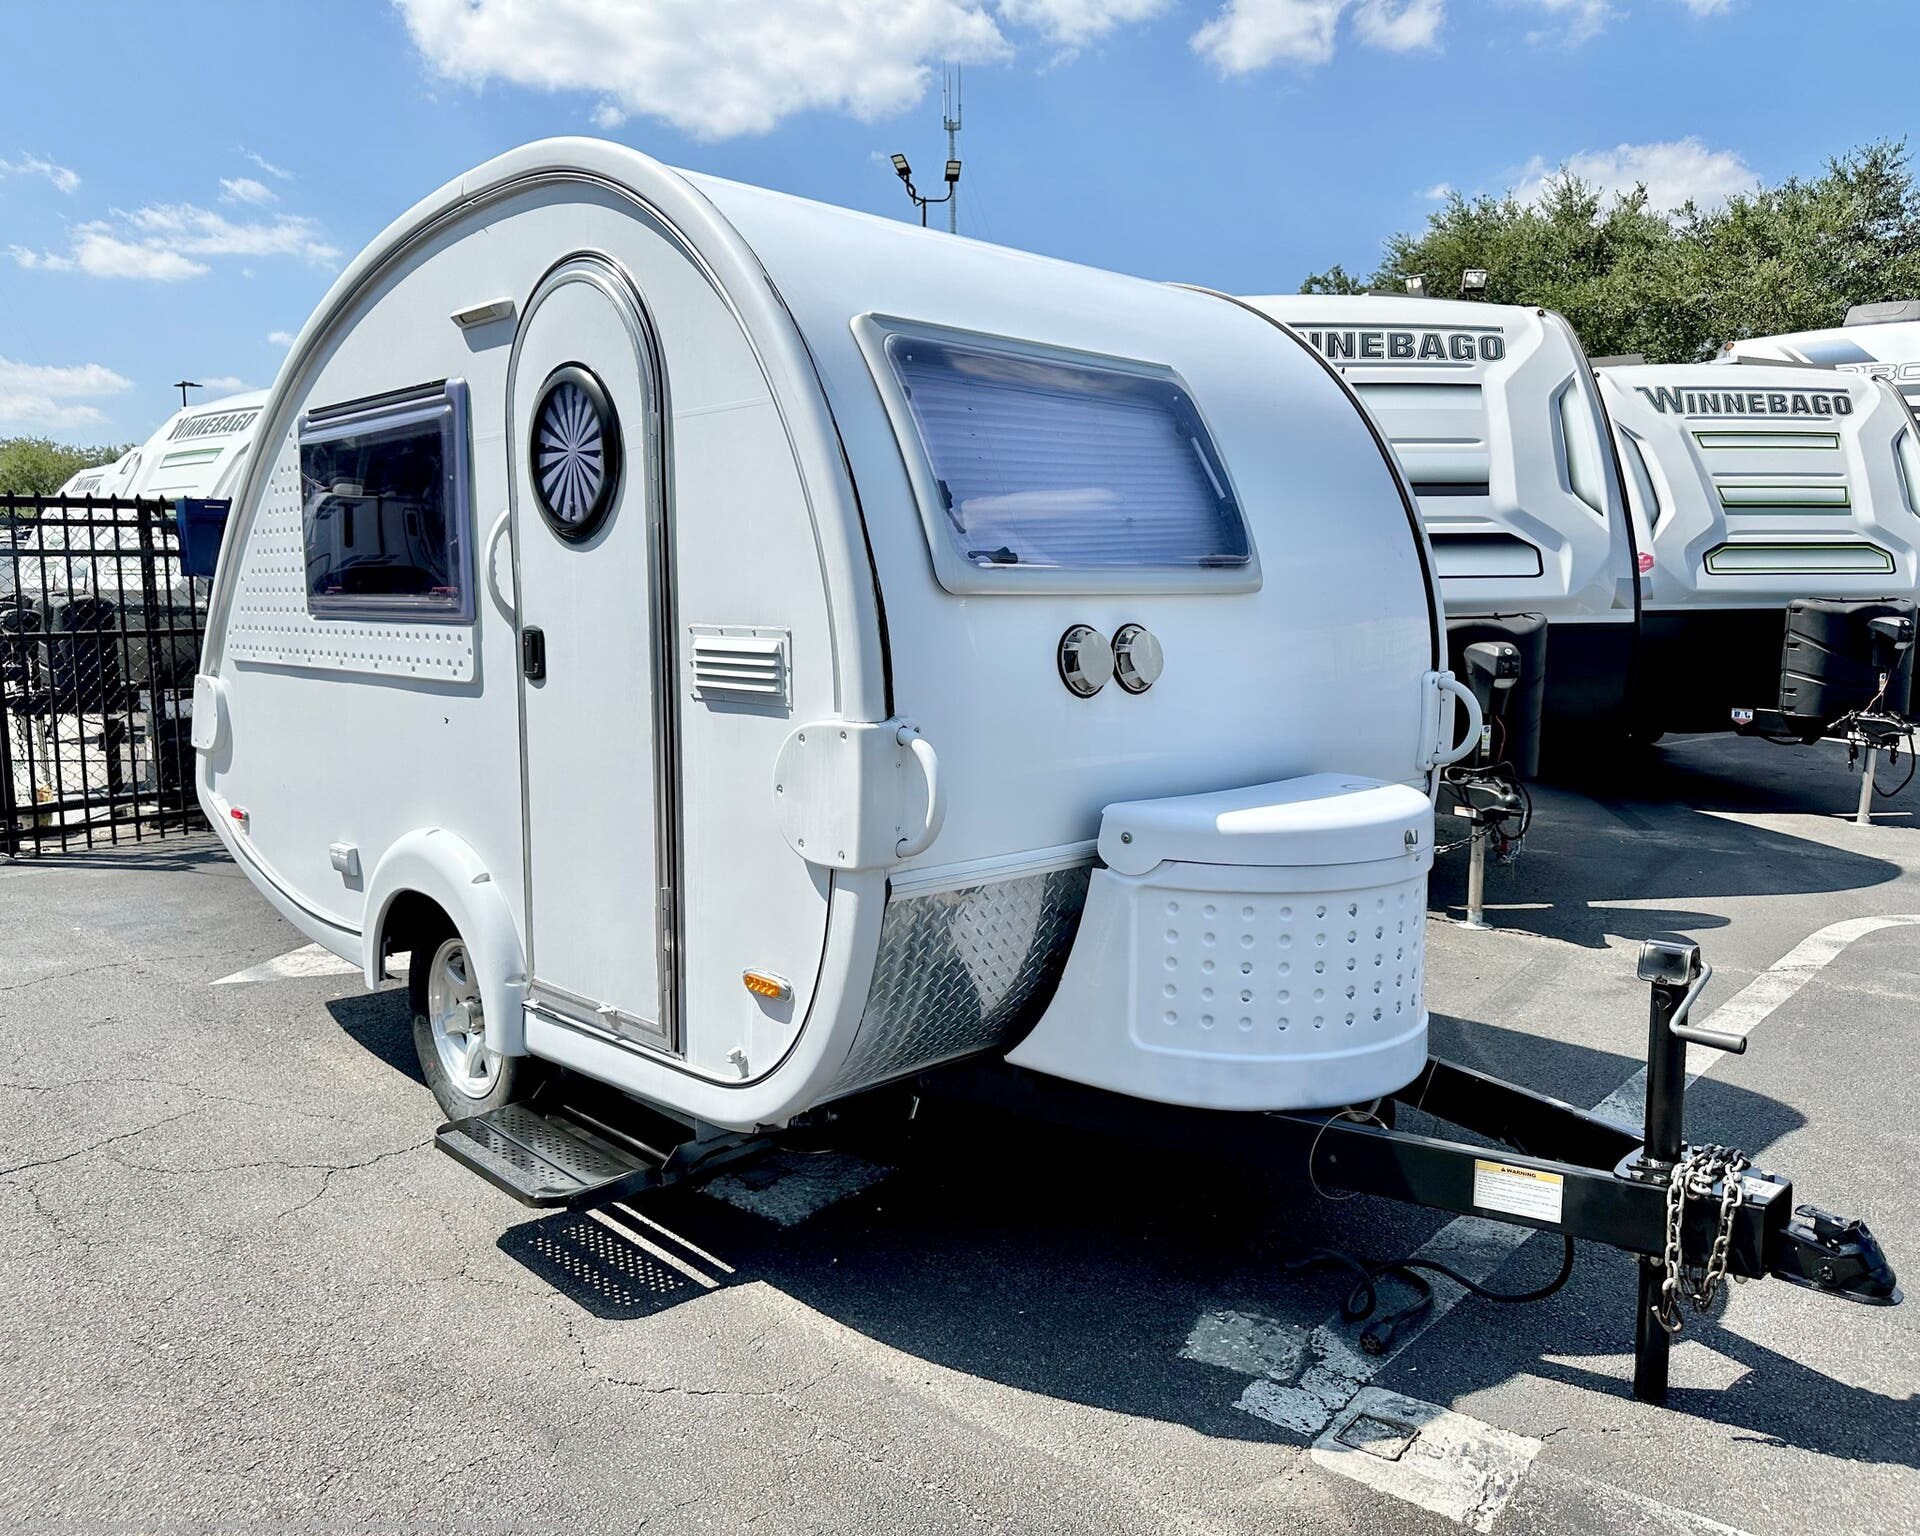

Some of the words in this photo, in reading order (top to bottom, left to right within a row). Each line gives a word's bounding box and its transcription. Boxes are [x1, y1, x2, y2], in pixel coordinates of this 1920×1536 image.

[1633, 386, 1854, 416] WINNEBAGO
[167, 411, 260, 441] WINNEBAGO
[1506, 1168, 1537, 1178] WARNING
